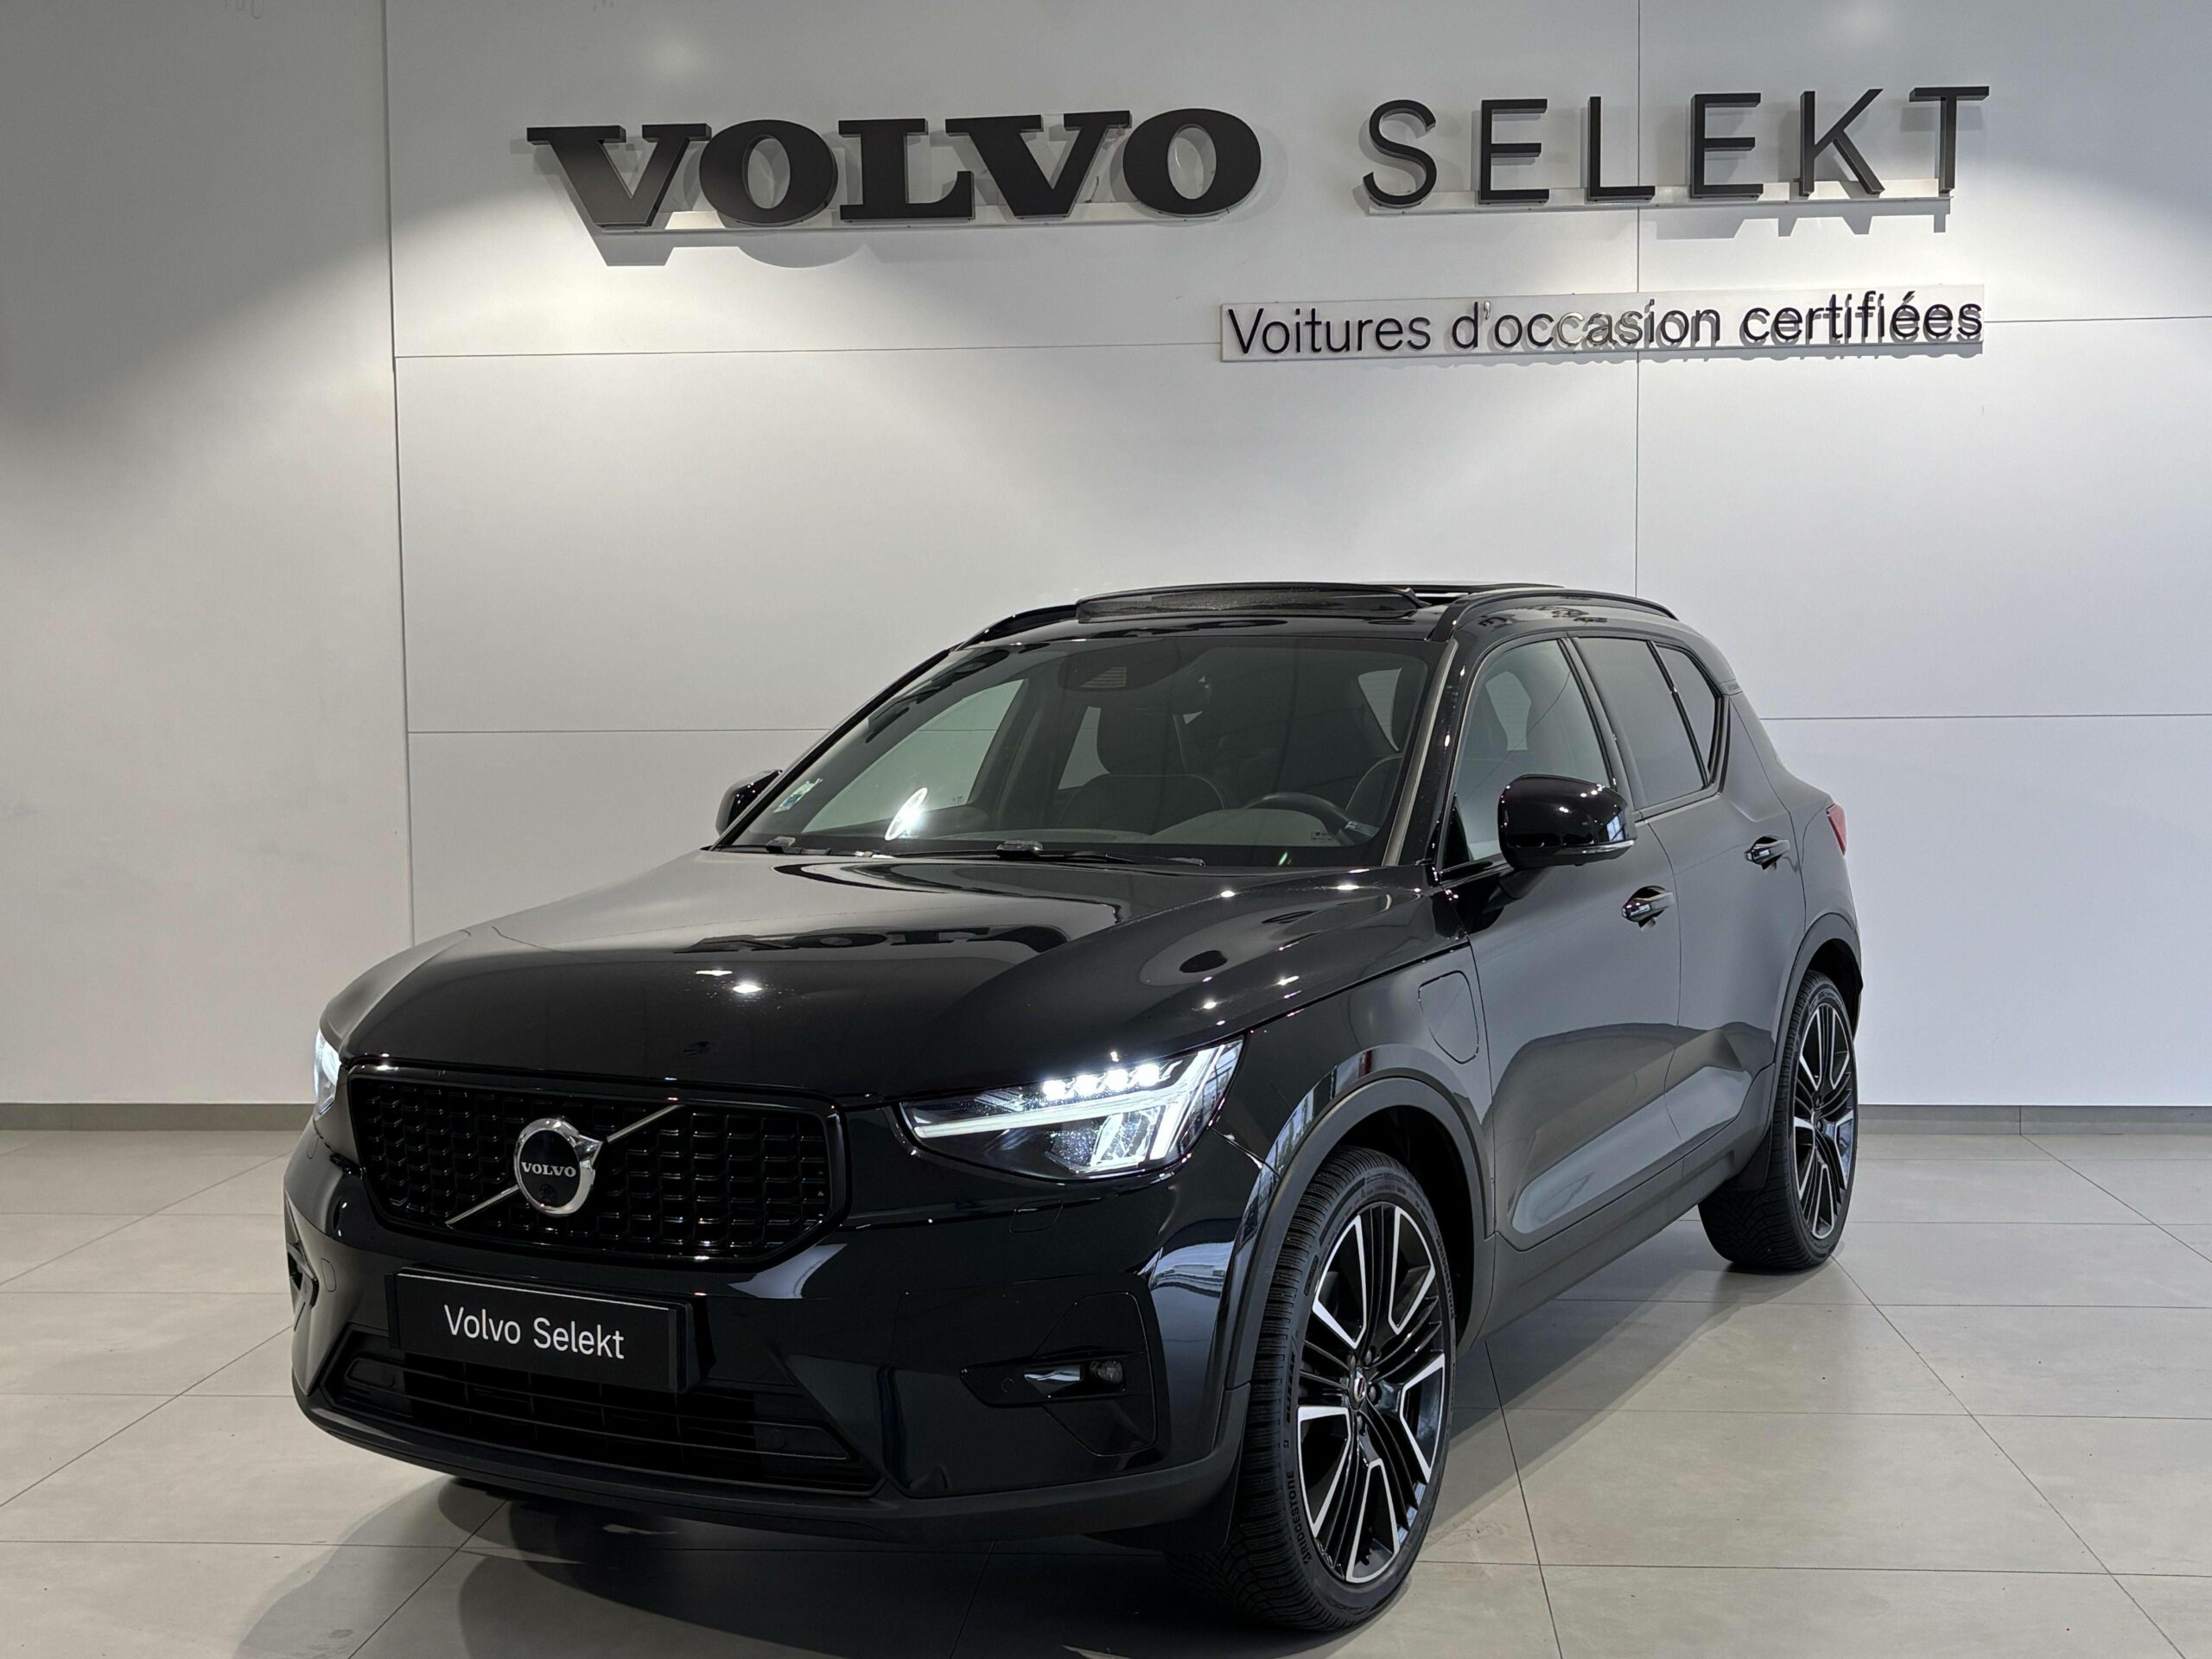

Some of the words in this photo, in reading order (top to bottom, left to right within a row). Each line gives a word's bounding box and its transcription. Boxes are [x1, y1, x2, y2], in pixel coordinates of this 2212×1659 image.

[526, 108, 1262, 226] VOLVO
[1363, 86, 1990, 208] SELEKT
[1227, 307, 1432, 355] Voitures
[1451, 298, 1721, 350] d'occasion
[1742, 289, 1983, 341] certifiées
[520, 1161, 577, 1178] VOLVO
[443, 1304, 522, 1345] Volvo
[532, 1317, 625, 1360] Selekt
